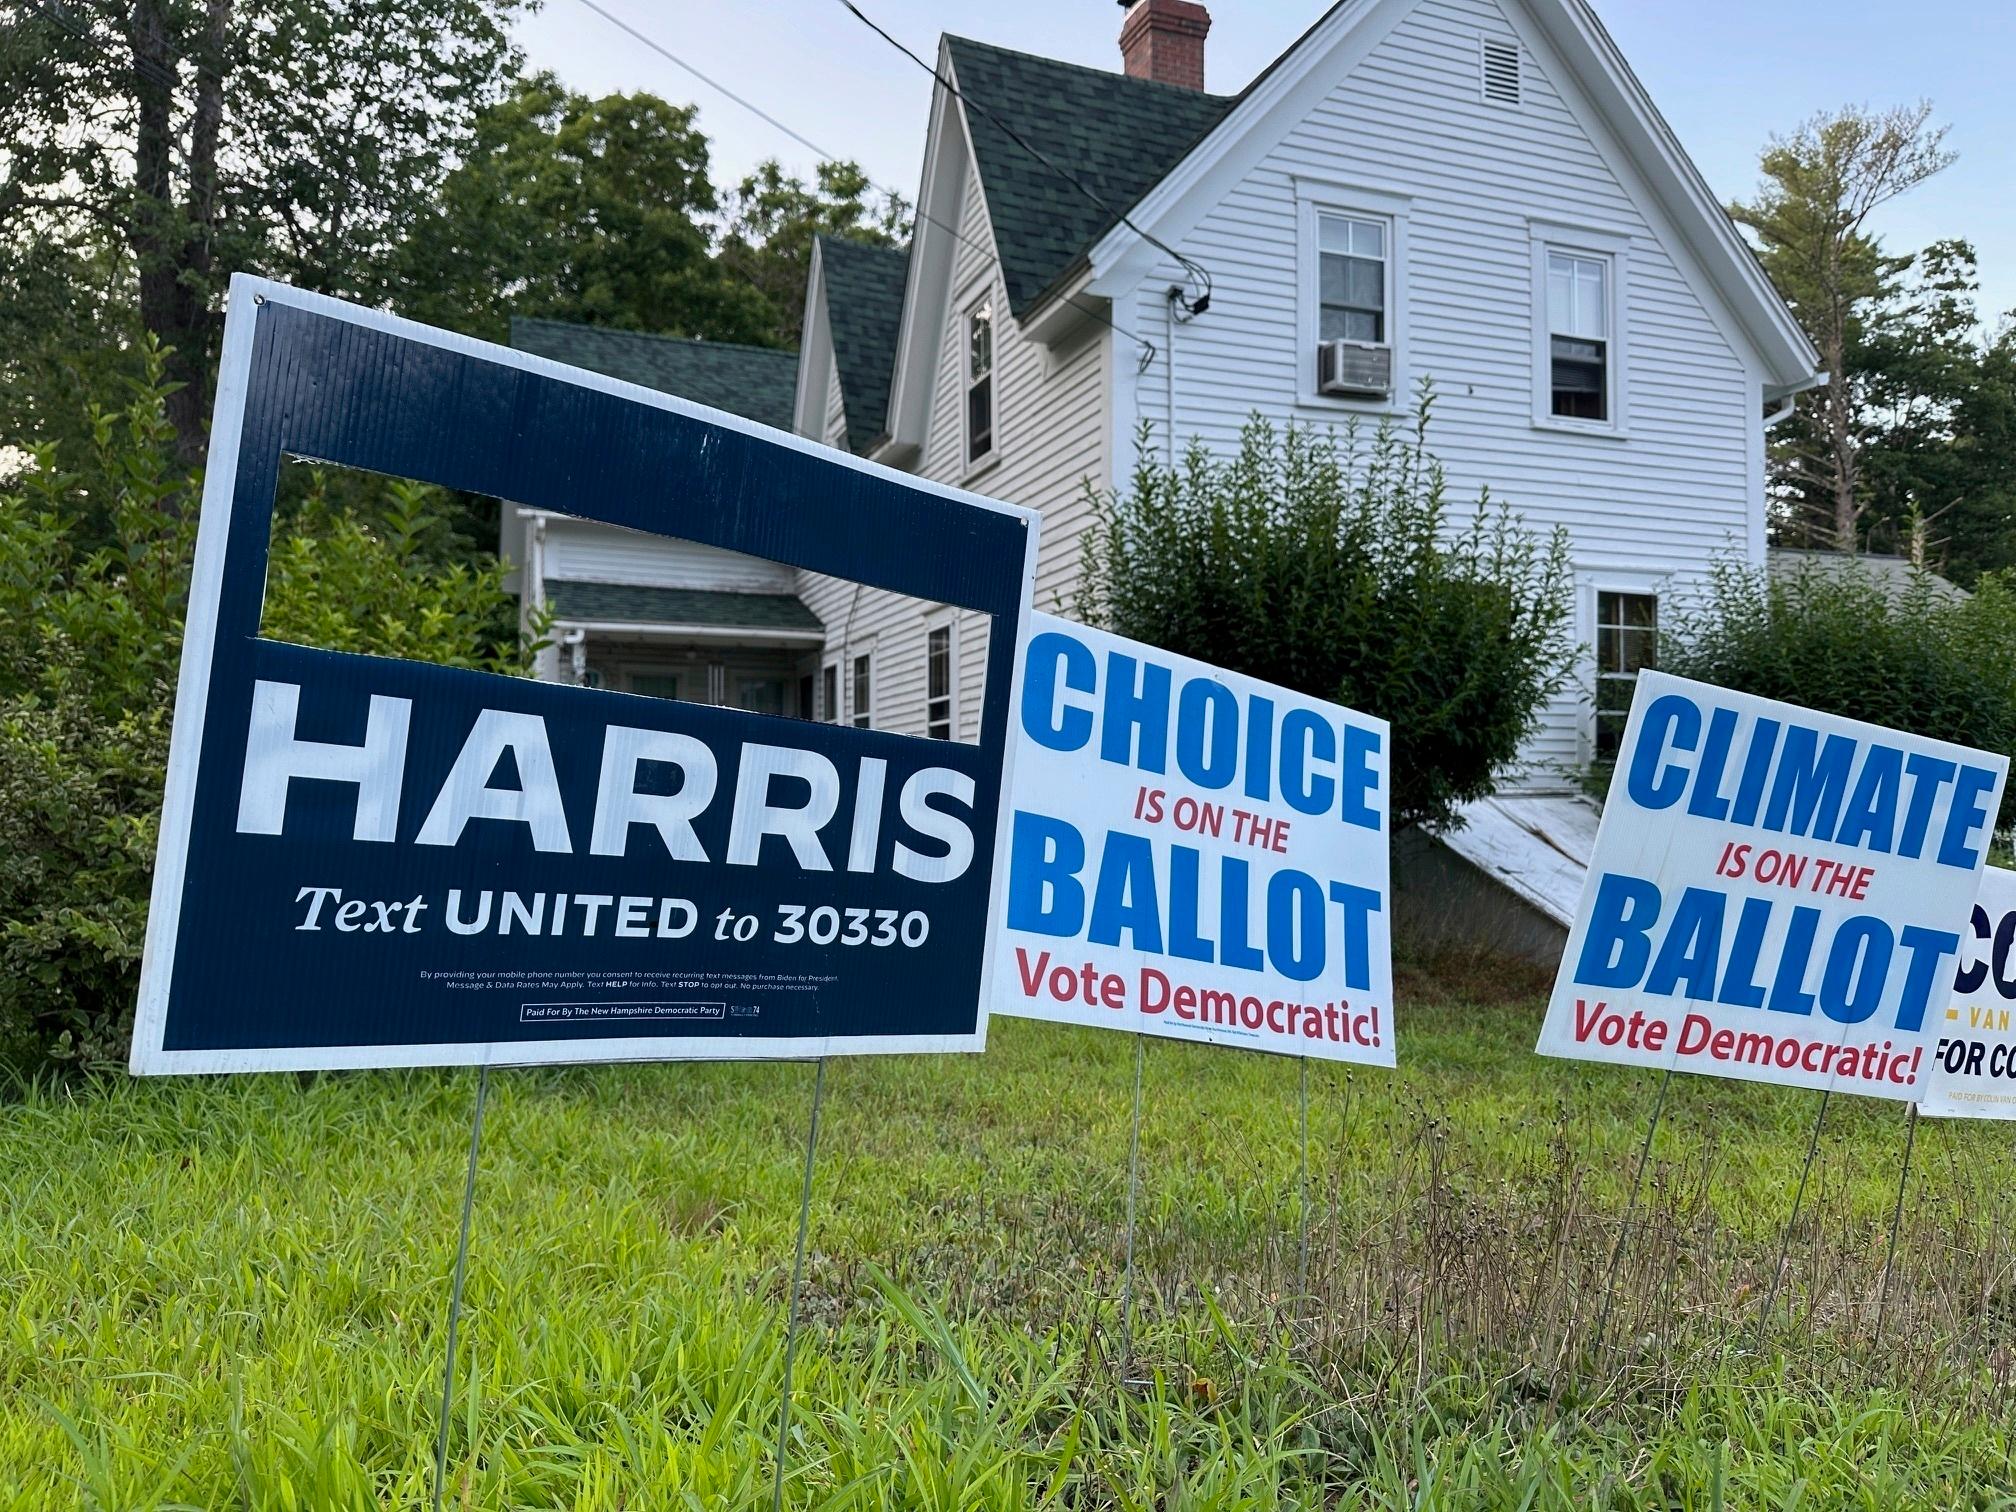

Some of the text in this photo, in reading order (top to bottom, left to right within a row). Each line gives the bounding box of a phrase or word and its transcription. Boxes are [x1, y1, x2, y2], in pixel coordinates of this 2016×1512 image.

[1020, 631, 1381, 832] CHOICE
[235, 678, 976, 884] HARRIS
[1627, 694, 1998, 871] CLIMATE
[1134, 786, 1291, 854] IS ON THE
[1006, 809, 1382, 992] BALLOT
[1716, 842, 1876, 901] IS ON THE
[294, 886, 930, 948] Text UNITED to 30330
[1573, 873, 1960, 1032] BALLOT
[420, 970, 432, 979] By
[434, 970, 475, 979] providing
[527, 971, 553, 979] phone
[672, 972, 705, 980] recurring
[721, 973, 757, 981] messages
[798, 974, 808, 982] for
[446, 981, 485, 990] Message
[486, 981, 494, 989] &
[495, 981, 515, 989] Data
[516, 981, 540, 989] Rates
[541, 981, 558, 989] May
[560, 981, 585, 989] Apply.
[605, 980, 628, 988] HELP
[660, 980, 677, 988] Text
[752, 982, 785, 990] purchase
[526, 1008, 545, 1016] Paid
[546, 1007, 561, 1016] For
[562, 1007, 573, 1017] By
[574, 1007, 590, 1015] The
[591, 1007, 609, 1015] New
[610, 1006, 653, 1015] Hampshire
[654, 1006, 699, 1014] Democratic
[700, 1006, 721, 1016] Party
[1015, 947, 1381, 1048] Vote Democratic!
[1576, 1000, 1923, 1085] Vote Democratic!
[1969, 1006, 2010, 1031] VAN
